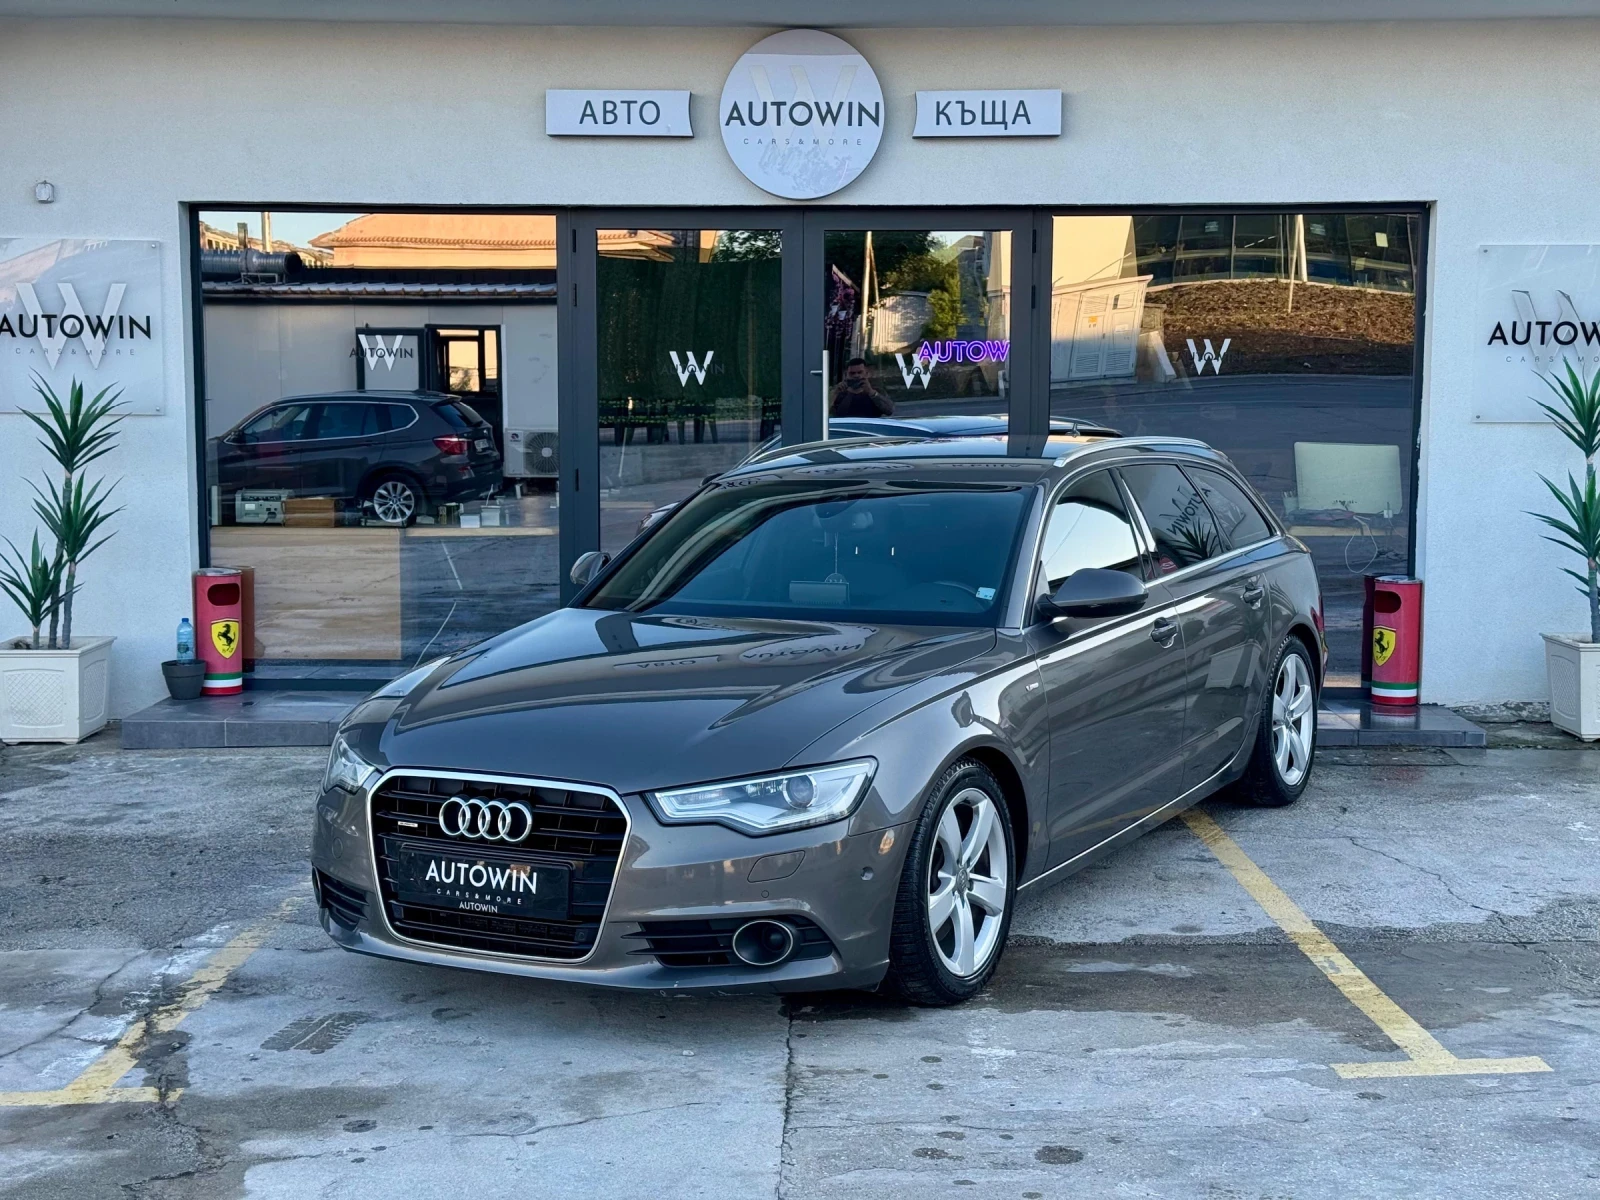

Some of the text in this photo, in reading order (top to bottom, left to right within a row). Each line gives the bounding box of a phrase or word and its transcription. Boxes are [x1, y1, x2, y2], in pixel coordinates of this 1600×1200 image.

[579, 99, 661, 125] АВТО
[724, 100, 880, 128] AUTOWIN
[935, 99, 1031, 130] КЪЩА
[0, 313, 152, 340] AUTOWIN
[349, 347, 414, 359] AUTOWIN
[919, 340, 1010, 362] AUTOW
[425, 859, 538, 895] AUTOWIN
[458, 901, 498, 914] AUTOWIN
